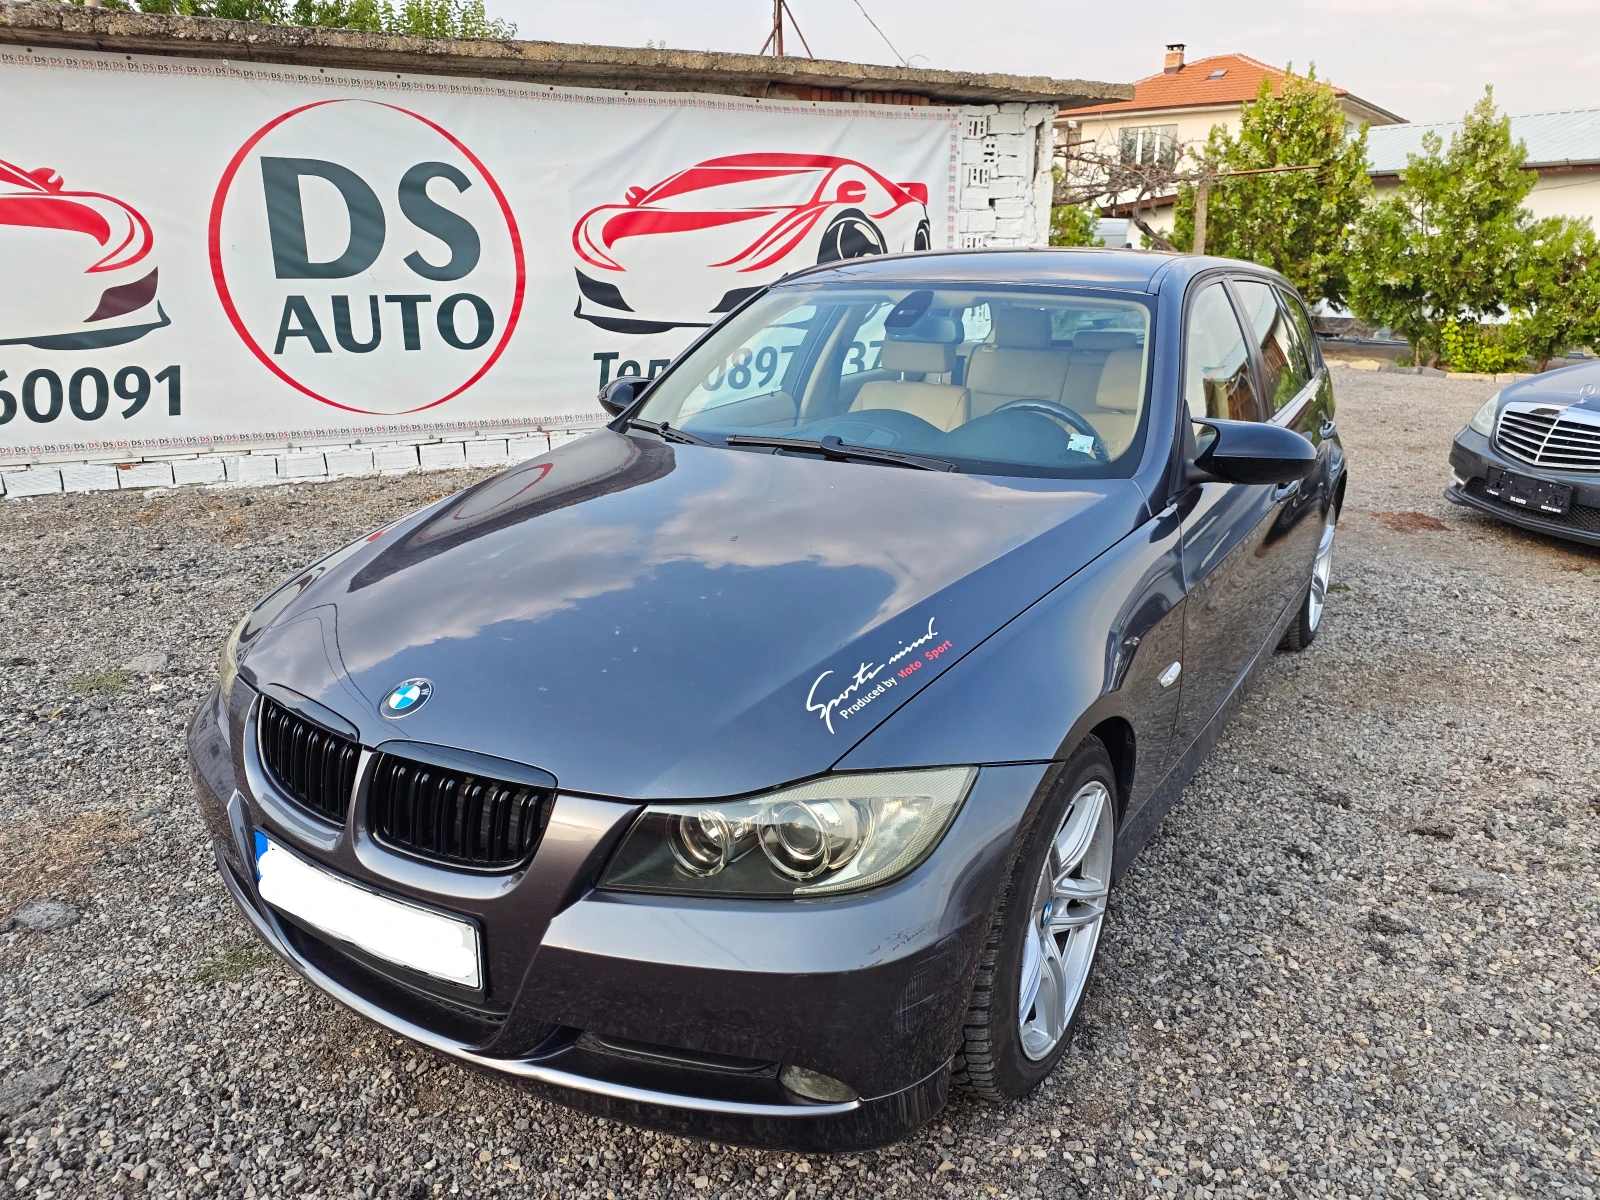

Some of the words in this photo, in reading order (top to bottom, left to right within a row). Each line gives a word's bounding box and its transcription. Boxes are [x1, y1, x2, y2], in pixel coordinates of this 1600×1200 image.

[260, 156, 481, 282] DS
[274, 293, 495, 354] AUTO
[888, 617, 938, 664] mind
[840, 684, 885, 720] Produced
[884, 676, 898, 686] by
[925, 640, 953, 660] Sport
